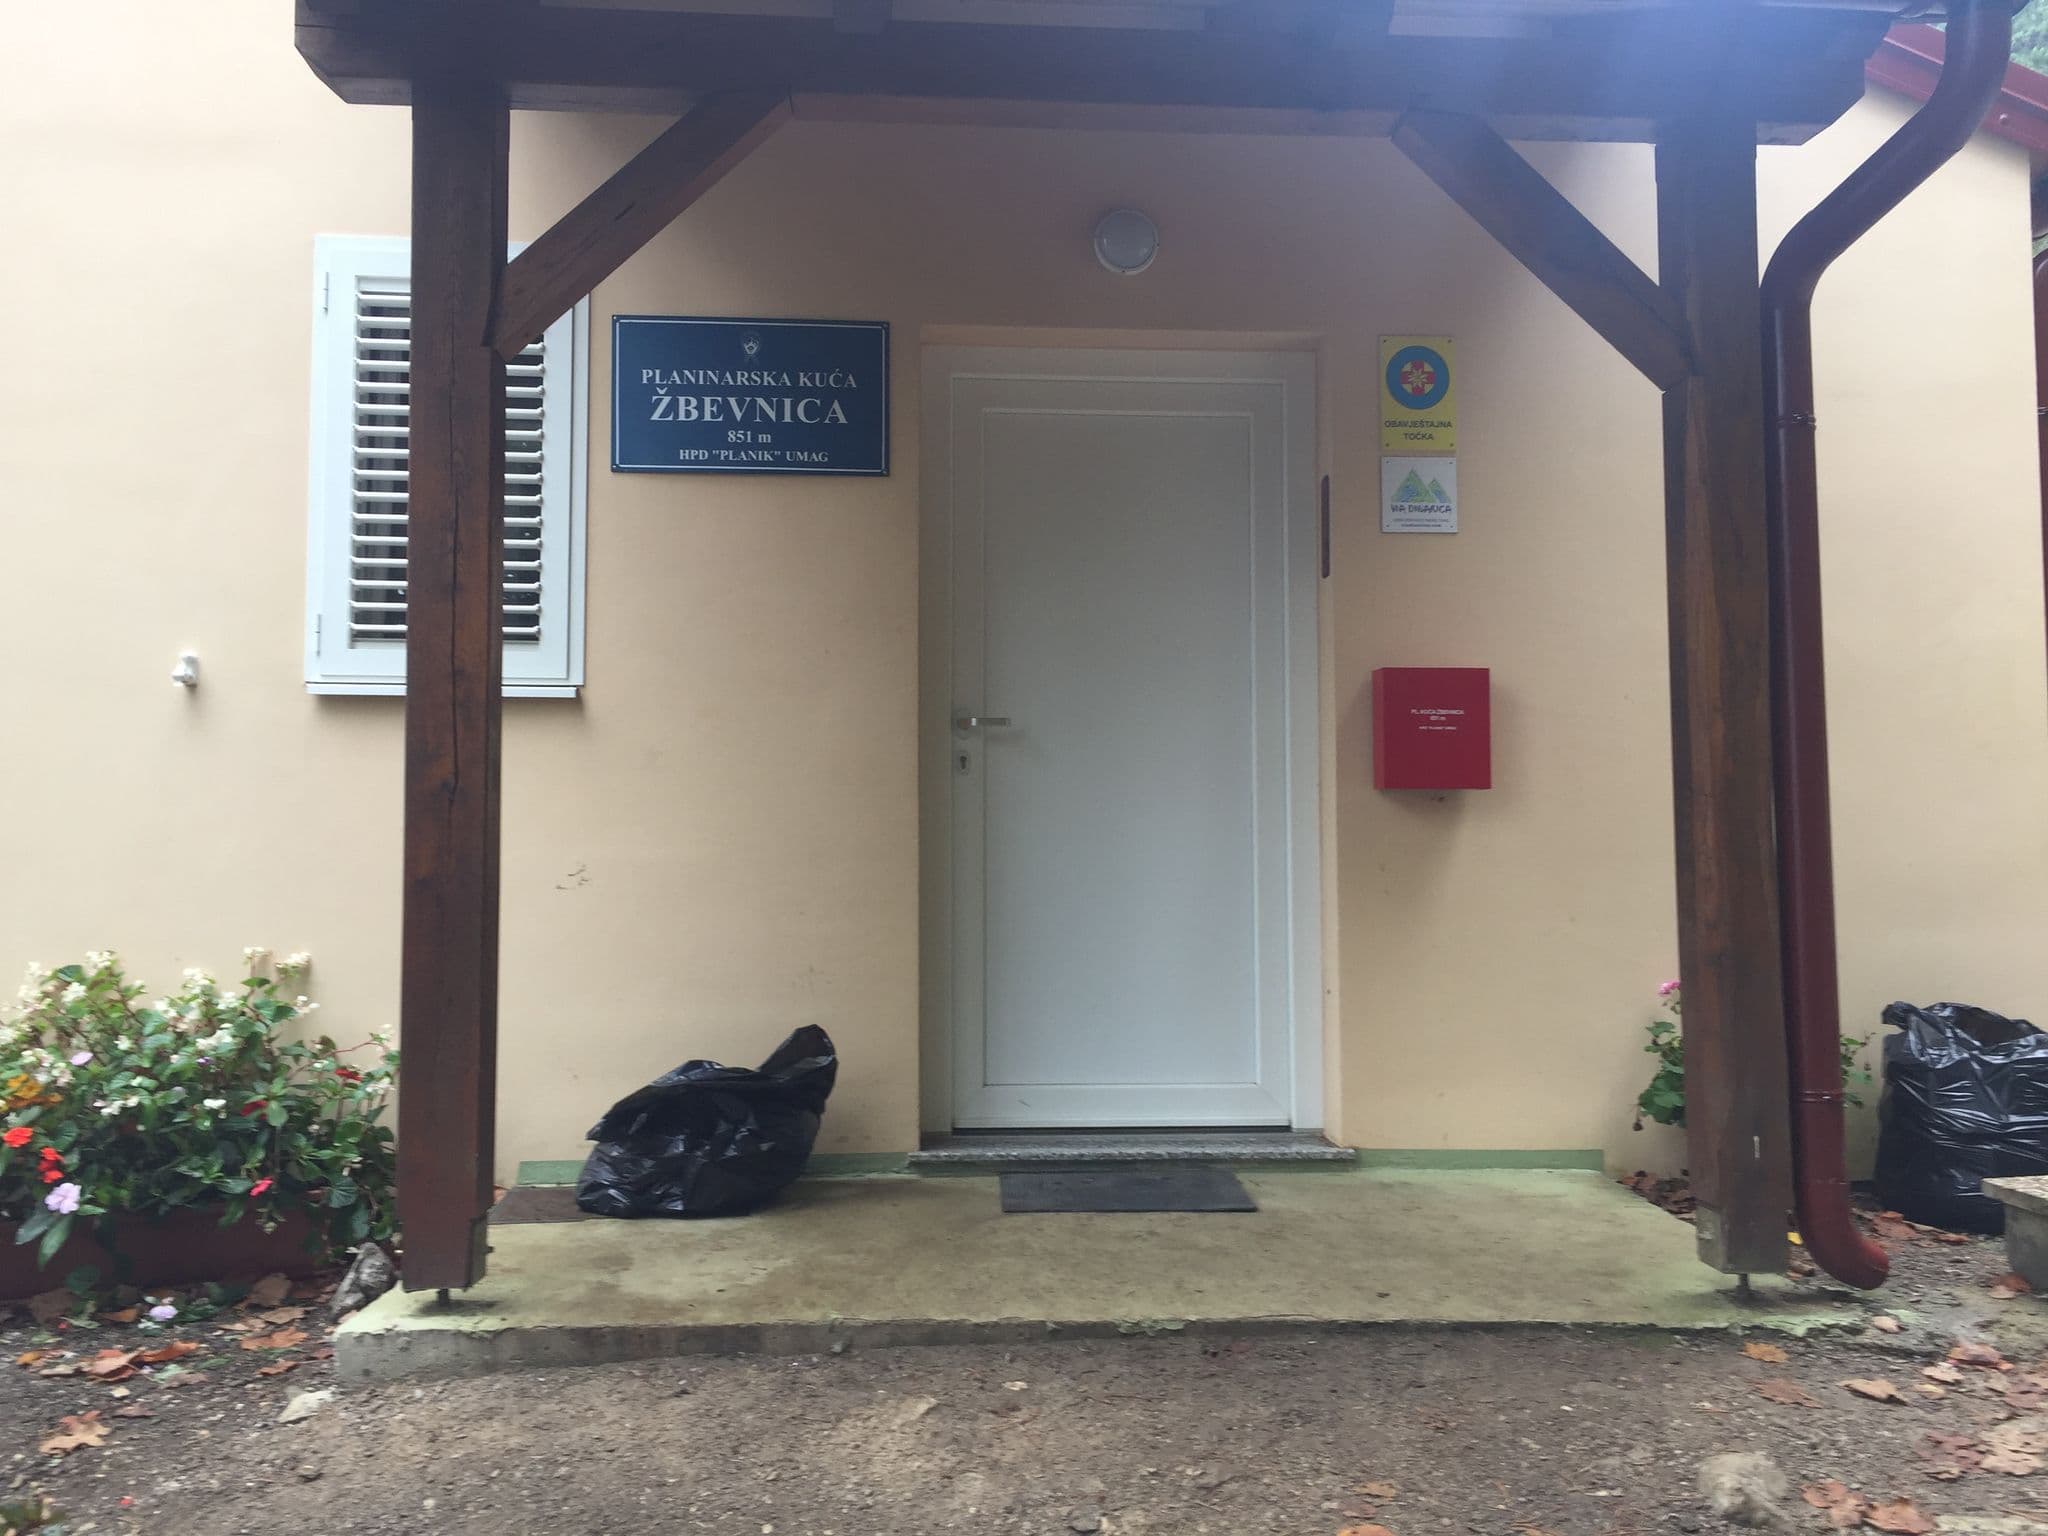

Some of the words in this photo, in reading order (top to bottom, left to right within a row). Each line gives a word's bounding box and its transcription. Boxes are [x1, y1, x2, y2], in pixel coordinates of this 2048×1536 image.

[641, 369, 792, 387] PLANINARSKA
[799, 368, 857, 388] KUĆA
[650, 387, 848, 424] ŽBEVNICA
[727, 430, 752, 444] 851
[758, 433, 772, 444] m
[1403, 430, 1434, 441] TOČKA
[679, 449, 709, 461] HPD
[712, 450, 781, 462] "PLANIK"
[786, 451, 829, 463] UMAG
